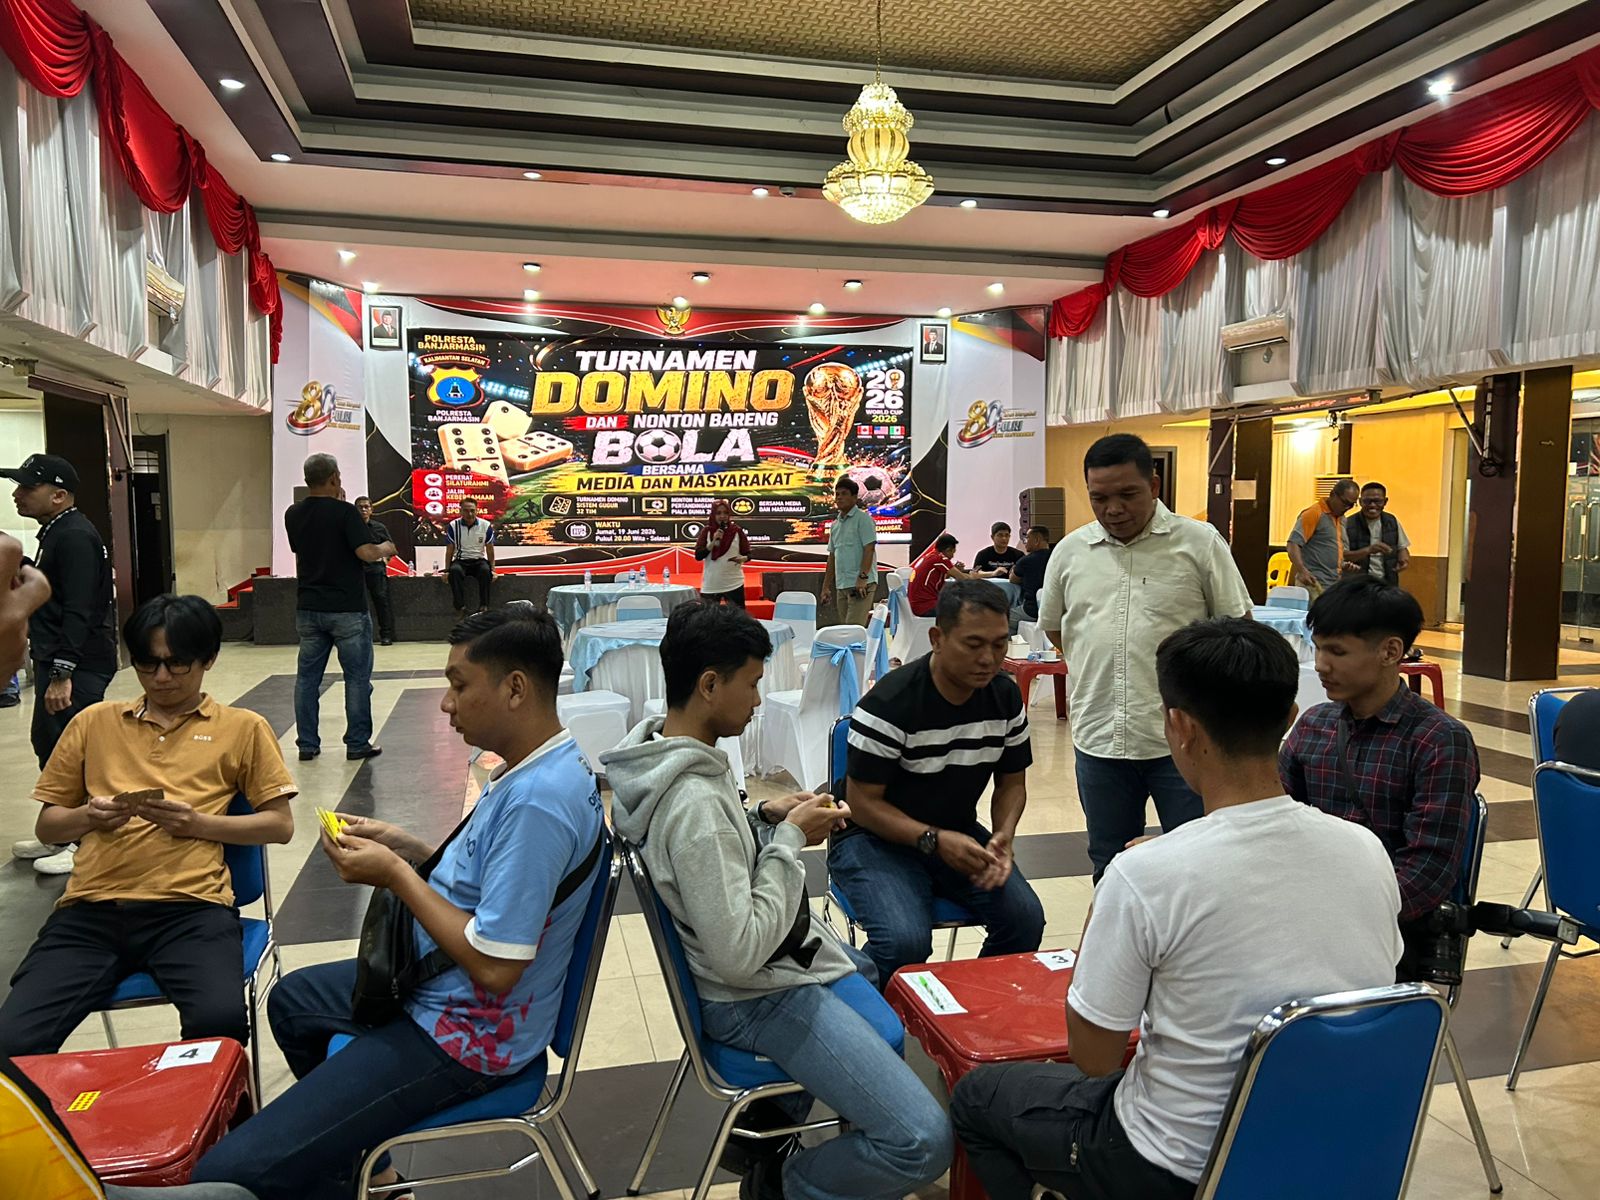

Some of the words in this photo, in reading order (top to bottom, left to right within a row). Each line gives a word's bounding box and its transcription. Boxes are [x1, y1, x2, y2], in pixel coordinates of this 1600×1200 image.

[424, 335, 476, 344] POLRESTA
[418, 342, 486, 352] BANJARMASIN
[461, 356, 486, 366] SELATAN
[576, 350, 758, 372] TURNAMEN
[530, 369, 796, 415] DOMINO
[428, 415, 480, 423] BANJARMASIN
[585, 416, 618, 429] DAN
[633, 413, 705, 429] NONTON
[709, 412, 778, 428] BARENG
[871, 415, 898, 423] 2026
[590, 428, 756, 465] BOLA
[642, 464, 705, 475] BERSAMA
[576, 476, 635, 490] MEDIA
[641, 477, 672, 489] DAN
[679, 473, 794, 488] MASYARAKAT
[178, 1047, 199, 1059] 4
